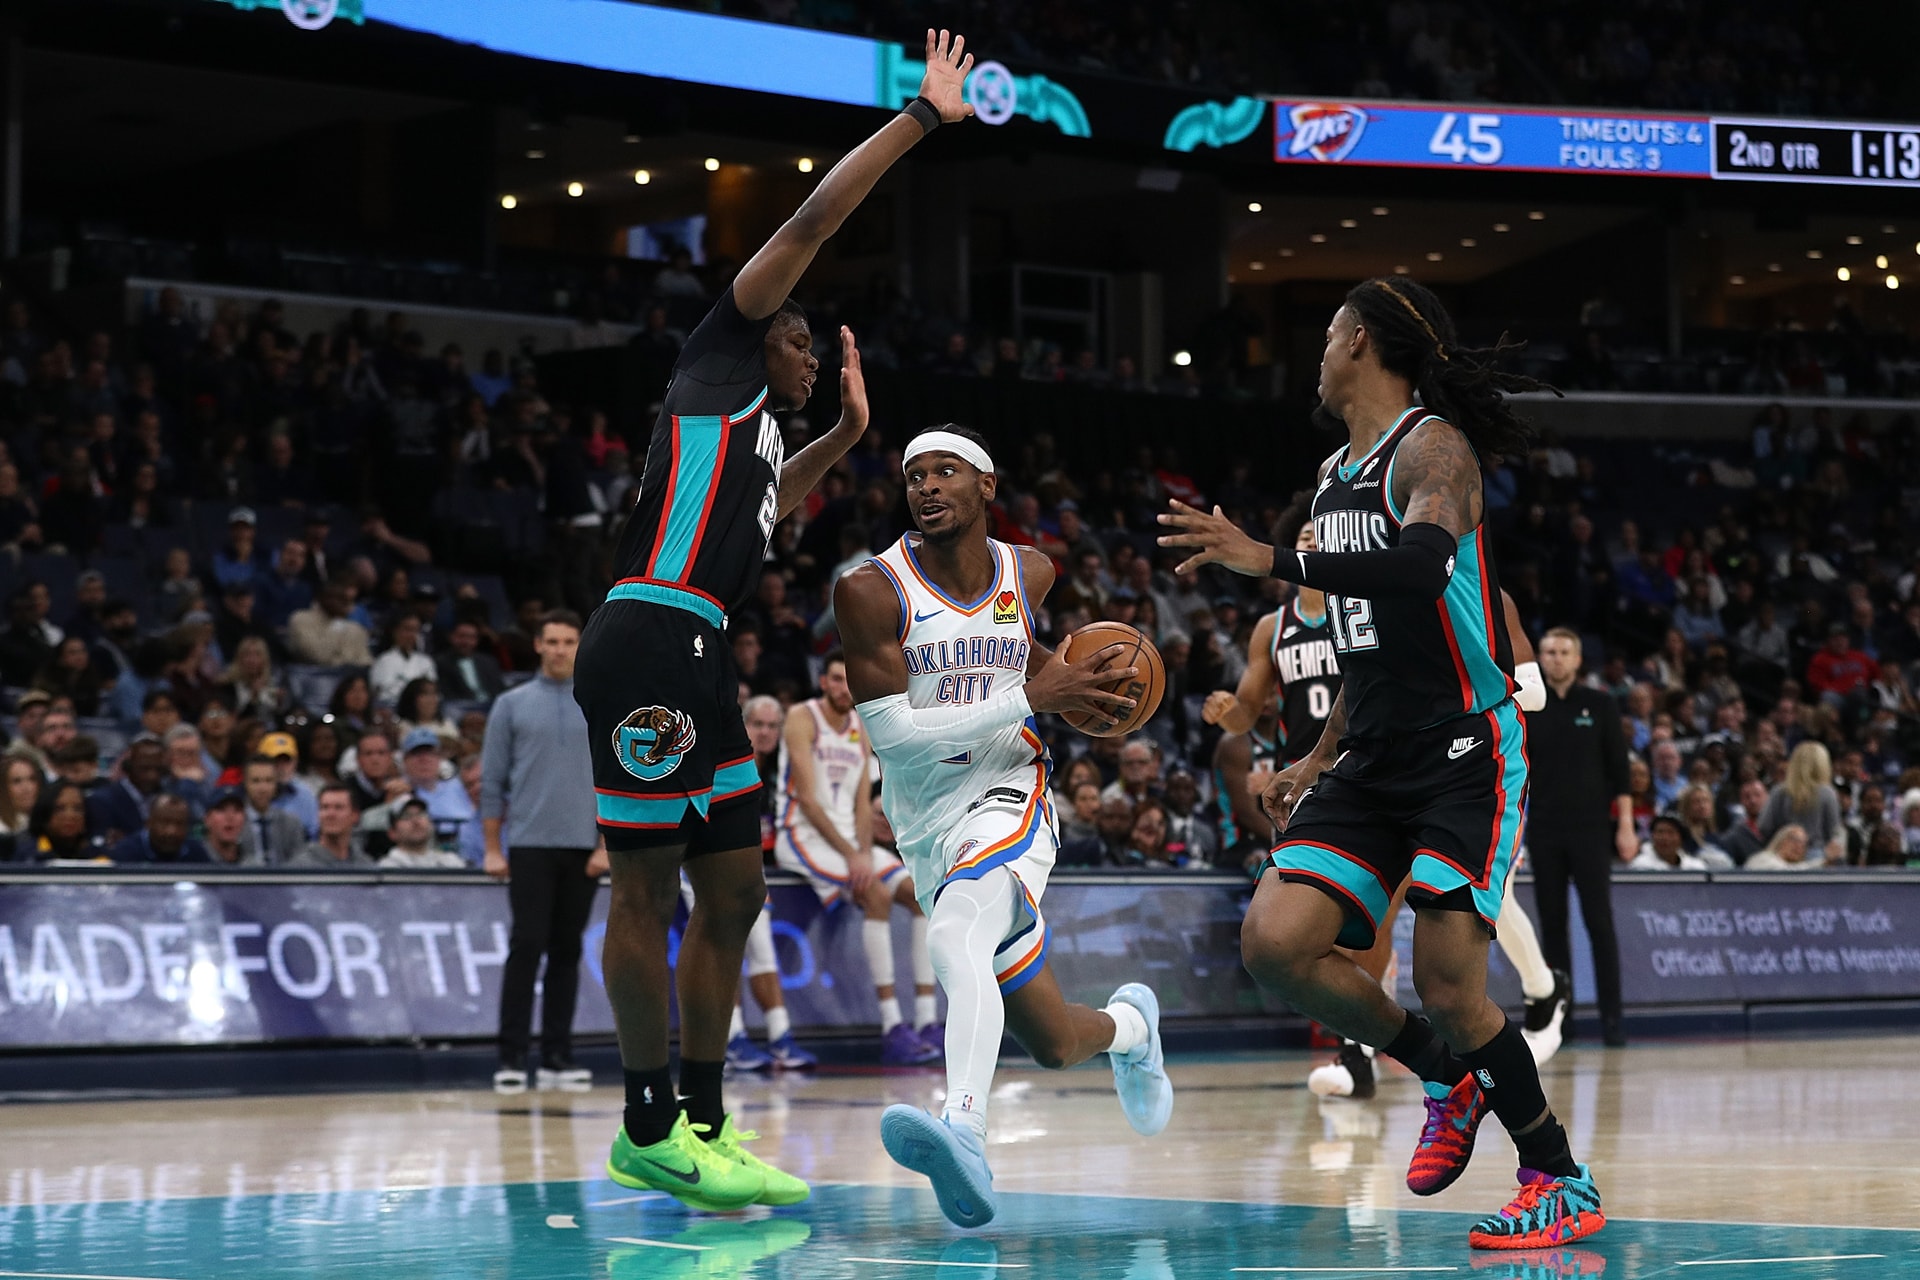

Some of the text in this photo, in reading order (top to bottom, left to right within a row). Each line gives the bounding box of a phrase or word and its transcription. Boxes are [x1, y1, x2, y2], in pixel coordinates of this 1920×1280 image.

[1429, 112, 1502, 165] 45
[1559, 117, 1704, 145] TIMEOUTS: 4
[1559, 144, 1662, 170] FOULS: 3
[1729, 130, 1820, 170] 2ND QTR
[1852, 131, 1920, 180] 1:13
[1352, 480, 1380, 490] Robinhood
[1326, 592, 1379, 653] 12
[902, 636, 1027, 676] OKLAHOMA
[1277, 639, 1340, 684] MEMPH
[936, 672, 995, 705] CITY
[1308, 683, 1331, 720] 0
[1452, 736, 1475, 751] NIKE
[1637, 909, 1681, 937] The
[1733, 908, 1780, 936] Ford
[1840, 907, 1892, 935] Truck
[221, 921, 390, 1001] FOR
[401, 921, 510, 998] TH
[1651, 949, 1726, 977] Official
[1726, 948, 1779, 975] Truck
[1782, 945, 1803, 973] of
[1804, 947, 1839, 973] the
